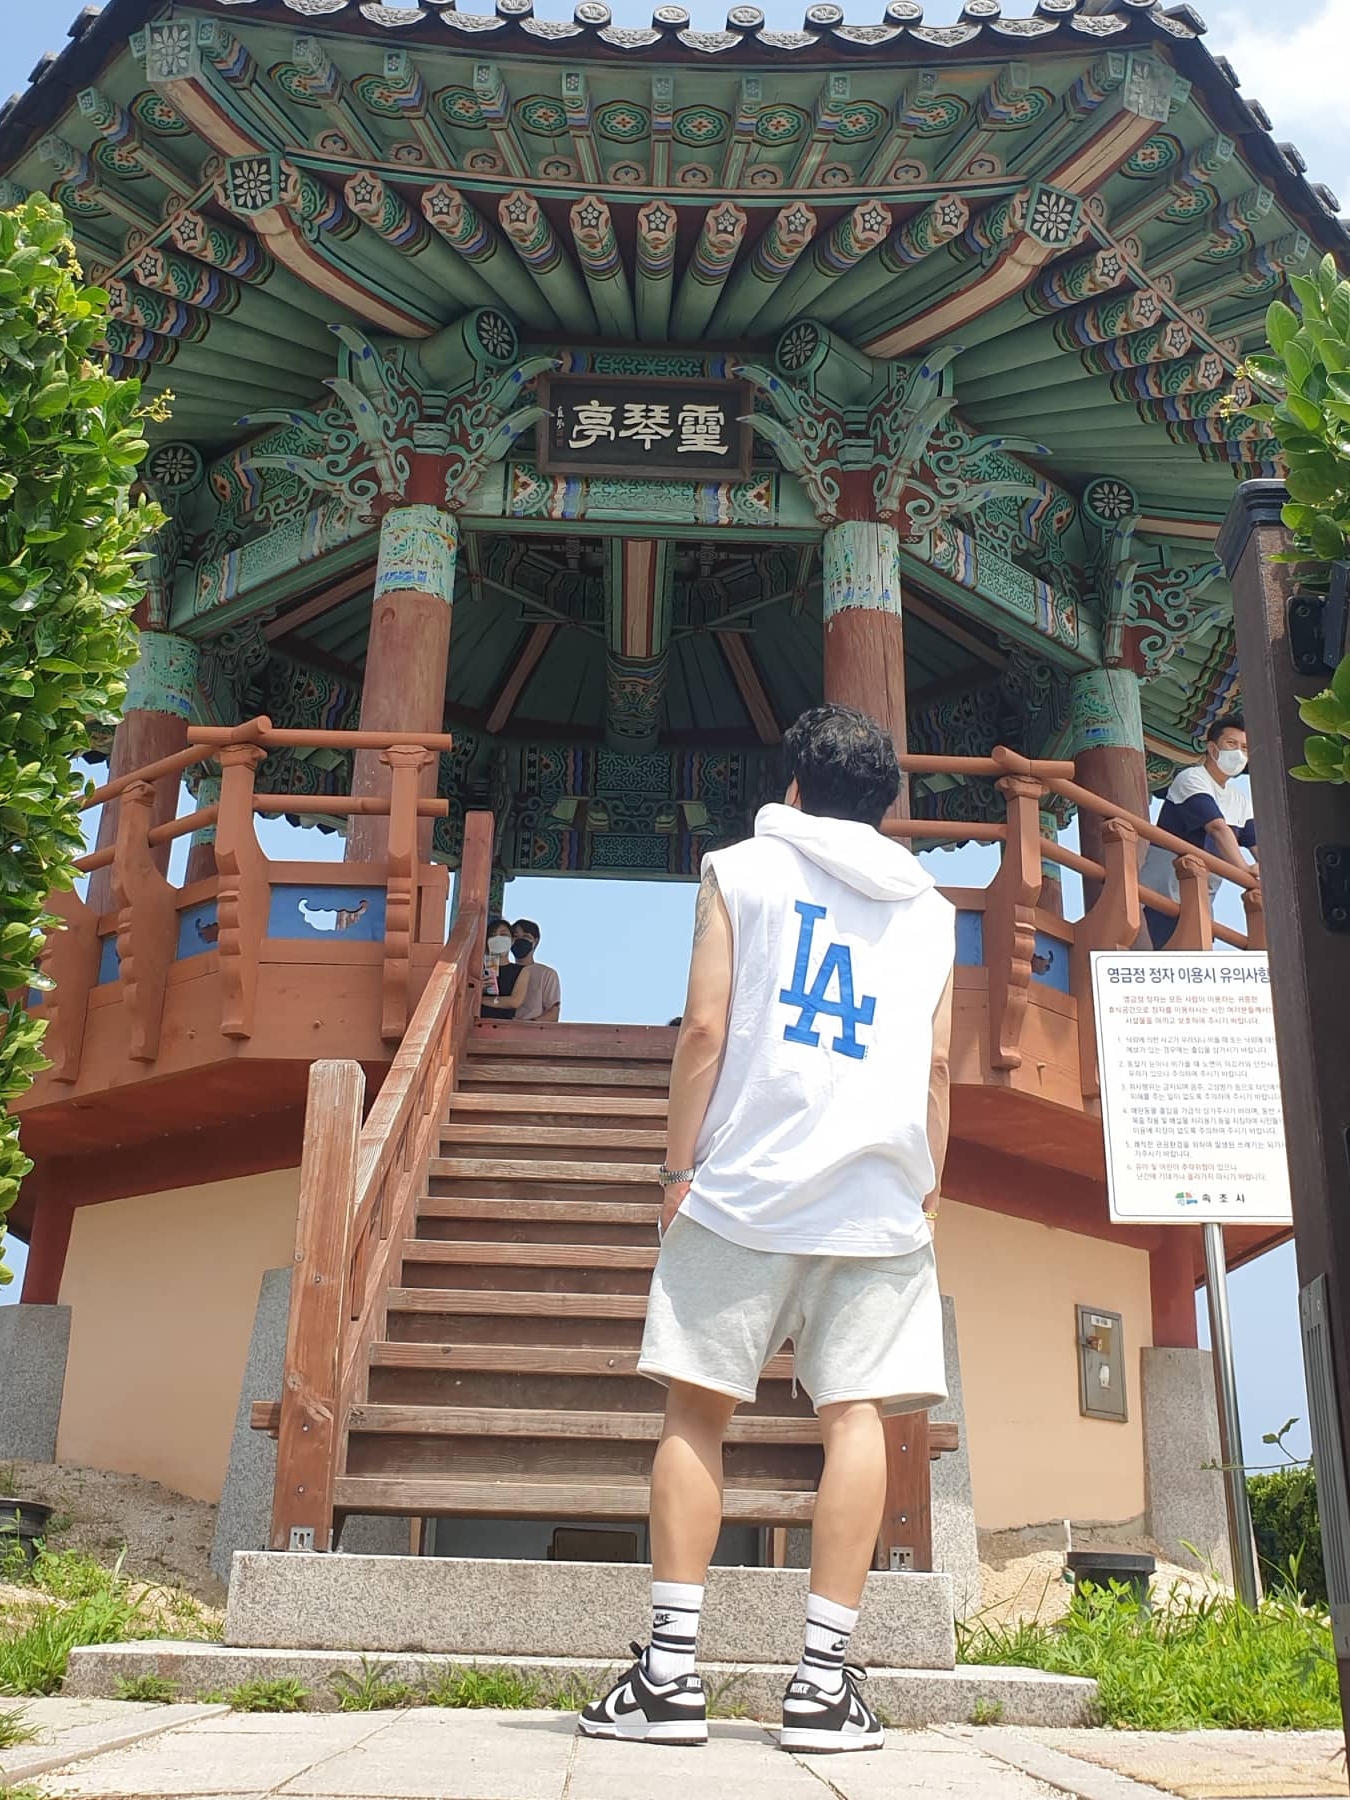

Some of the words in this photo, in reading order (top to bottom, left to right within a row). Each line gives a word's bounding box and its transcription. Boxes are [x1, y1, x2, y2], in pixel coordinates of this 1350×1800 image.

[779, 899, 877, 1060] LA
[1107, 967, 1146, 984] 영금정
[1149, 967, 1174, 984] 정자
[1178, 967, 1216, 984] 이용시
[790, 1682, 811, 1694] NIKE
